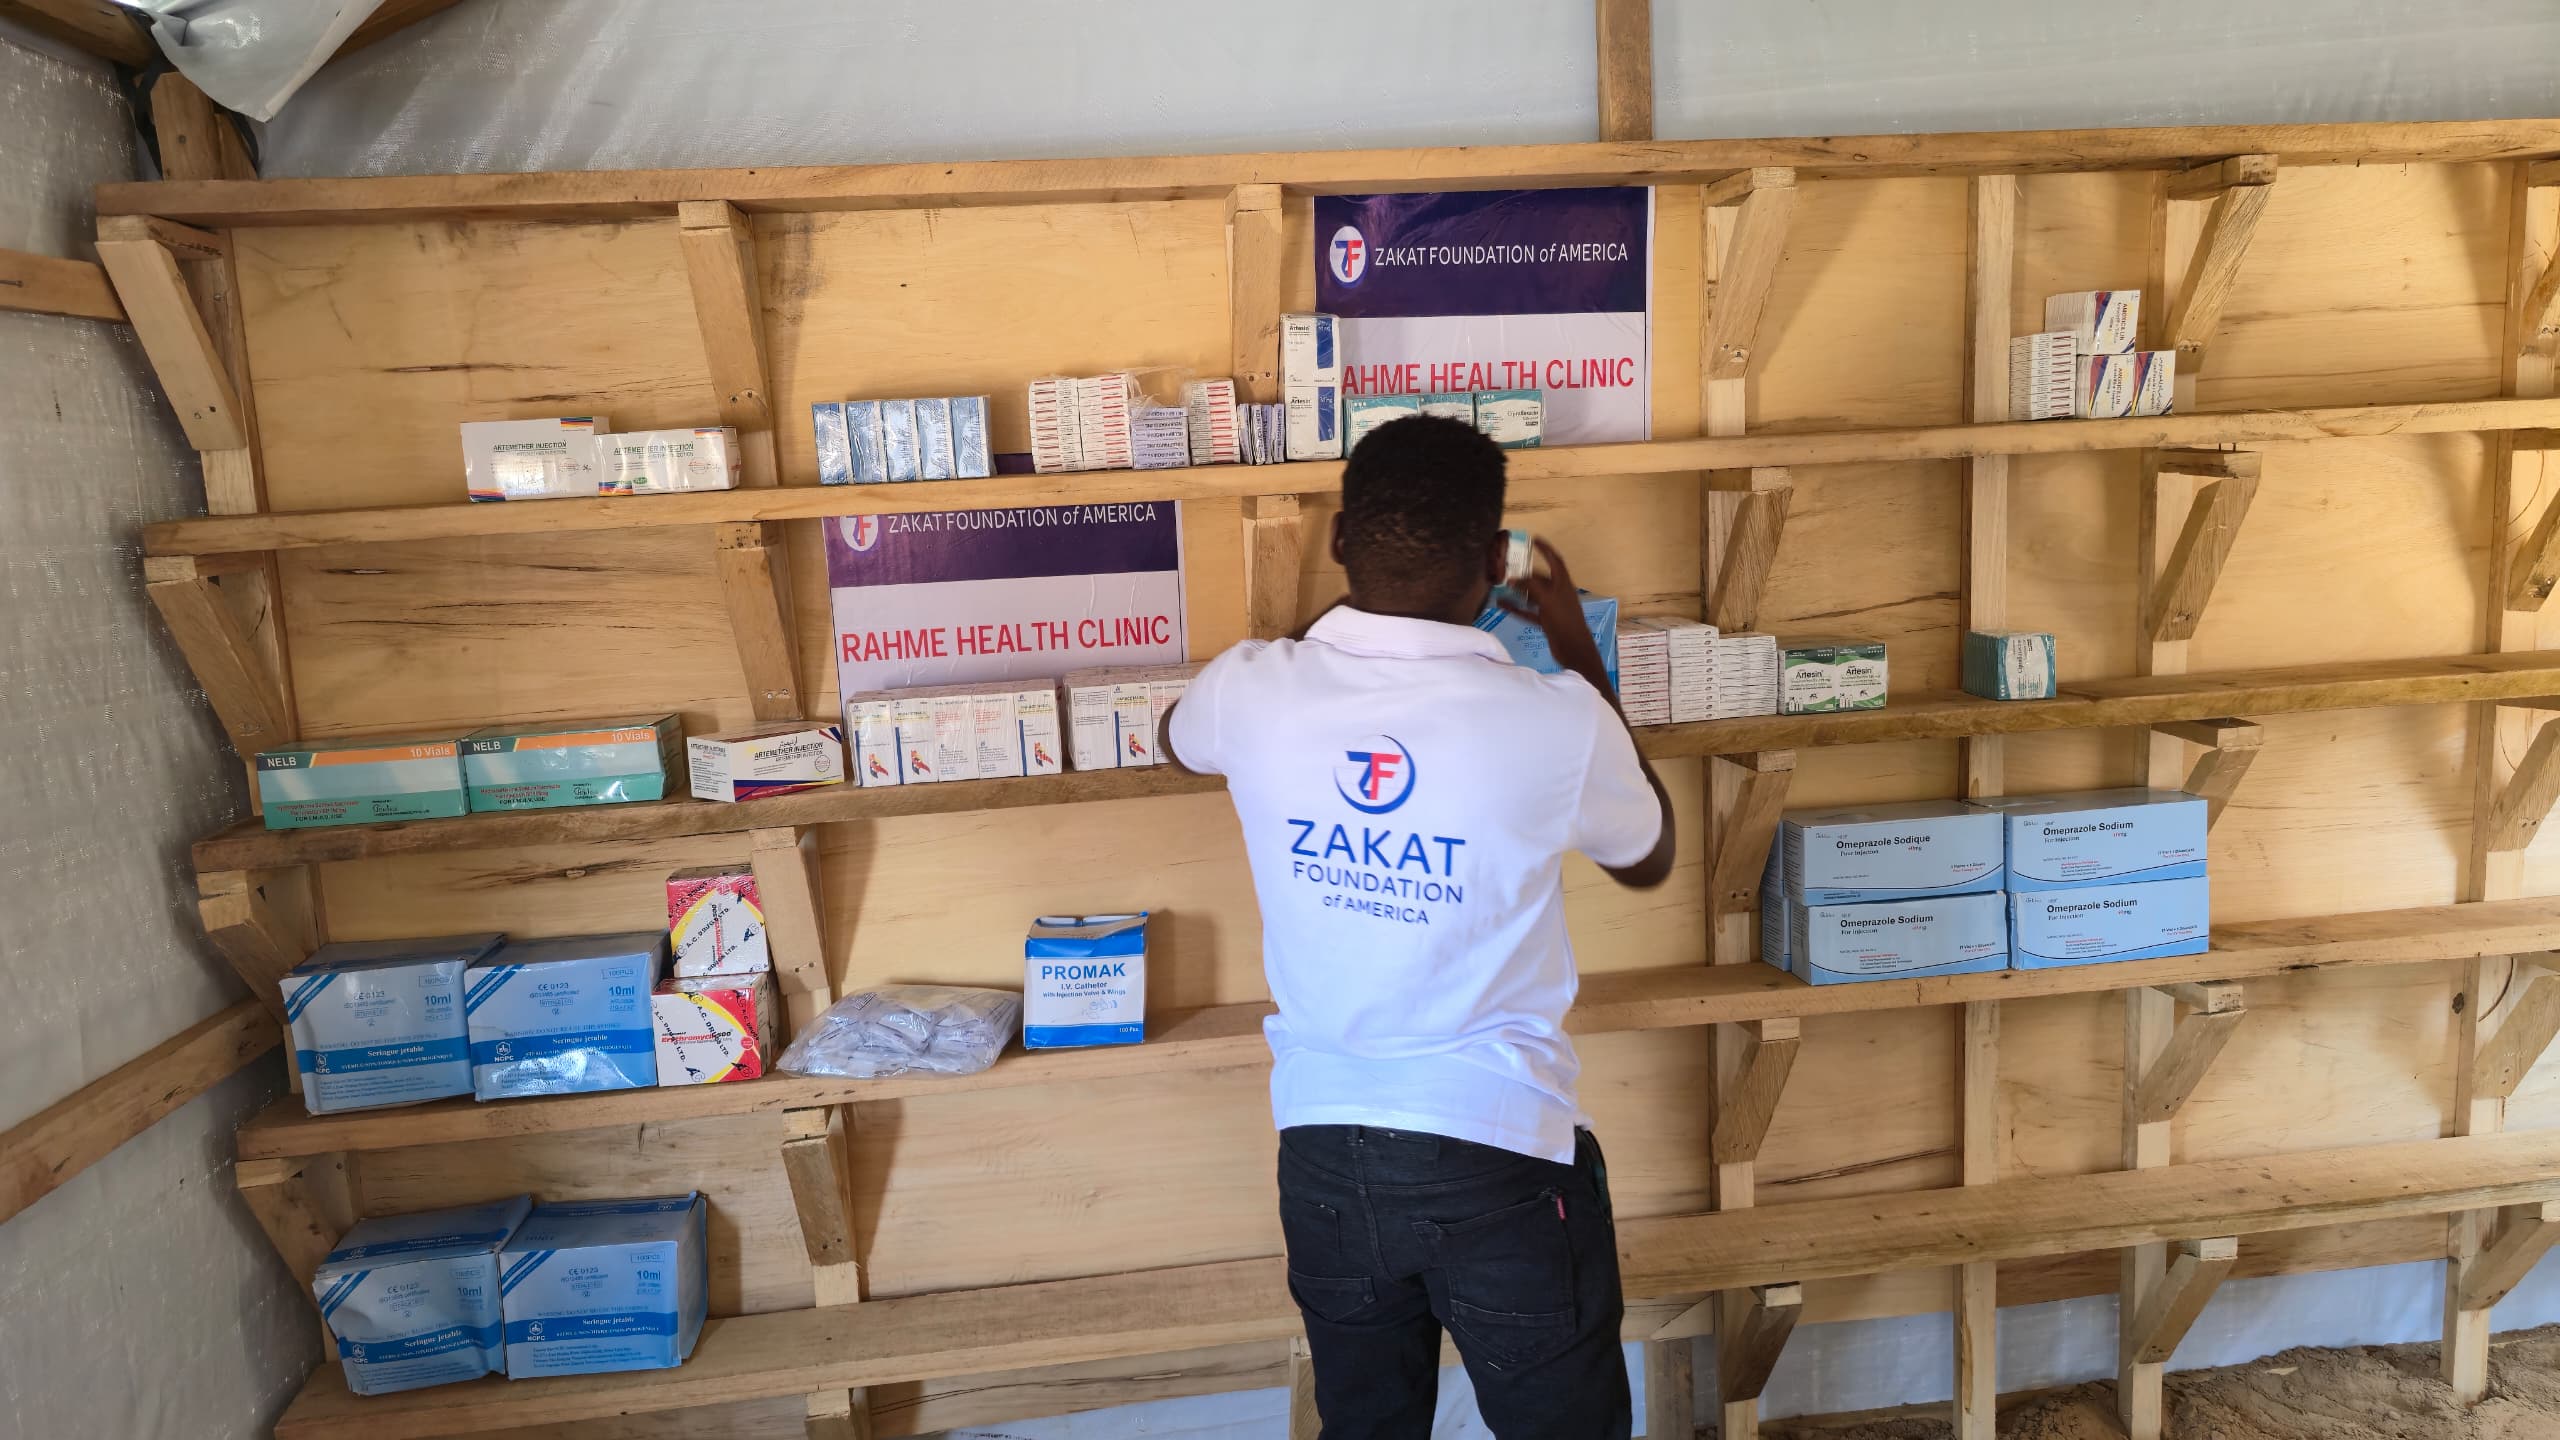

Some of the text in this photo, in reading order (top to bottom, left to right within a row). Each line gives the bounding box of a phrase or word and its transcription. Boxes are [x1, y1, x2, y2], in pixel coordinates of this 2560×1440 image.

[1375, 243, 1628, 267] ZAKAT FOUNDATION of AMERICA
[1341, 357, 1634, 395] AHME HEALTH CLINIC
[889, 504, 1156, 534] ZAKAT FOUNDATION of AMERICA
[841, 615, 1170, 663] RAHME HEALTH CLINIC
[625, 731, 650, 741] Vials
[424, 746, 450, 756] Vials
[473, 740, 501, 751] NELB
[267, 756, 297, 768] NELB
[2043, 820, 2134, 837] Omeprazole Sodium
[1287, 818, 1466, 877] ZAKAT
[1836, 834, 1931, 849] Omeprazole Sodique
[1293, 861, 1464, 904] FOUNDATION
[1323, 894, 1430, 924] of AMERICA
[2047, 897, 2138, 914] Omeprazole Sodium
[1840, 913, 1934, 928] Omeprazole Sodium
[1041, 962, 1126, 980] PROMAK
[608, 985, 635, 996] 10ml
[1074, 981, 1107, 990] Catheter
[424, 993, 451, 1006] 10ml
[636, 1270, 662, 1281] 10ml
[457, 1286, 482, 1297] 10ml
